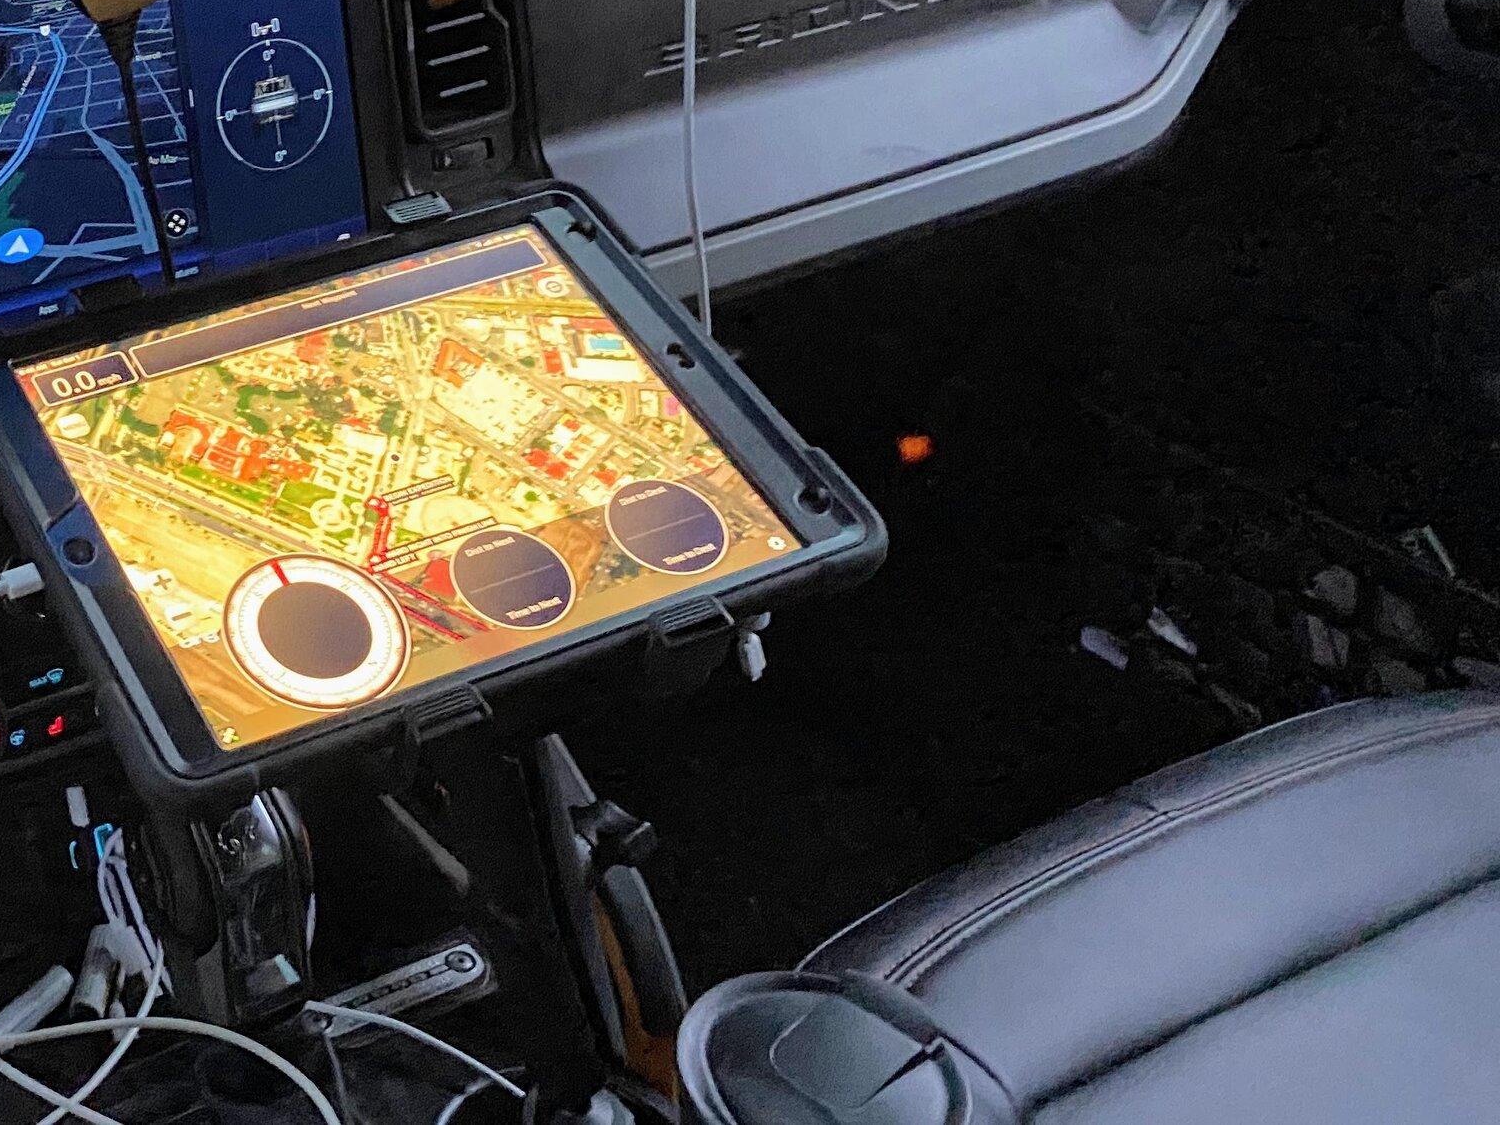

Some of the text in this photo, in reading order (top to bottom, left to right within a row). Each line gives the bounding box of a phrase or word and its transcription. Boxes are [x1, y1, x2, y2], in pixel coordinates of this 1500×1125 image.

[619, 496, 638, 506] Dist
[465, 536, 515, 557] Dist to Next
[663, 554, 687, 565] Time
[684, 551, 696, 559] to
[506, 597, 562, 620] Time to Next
